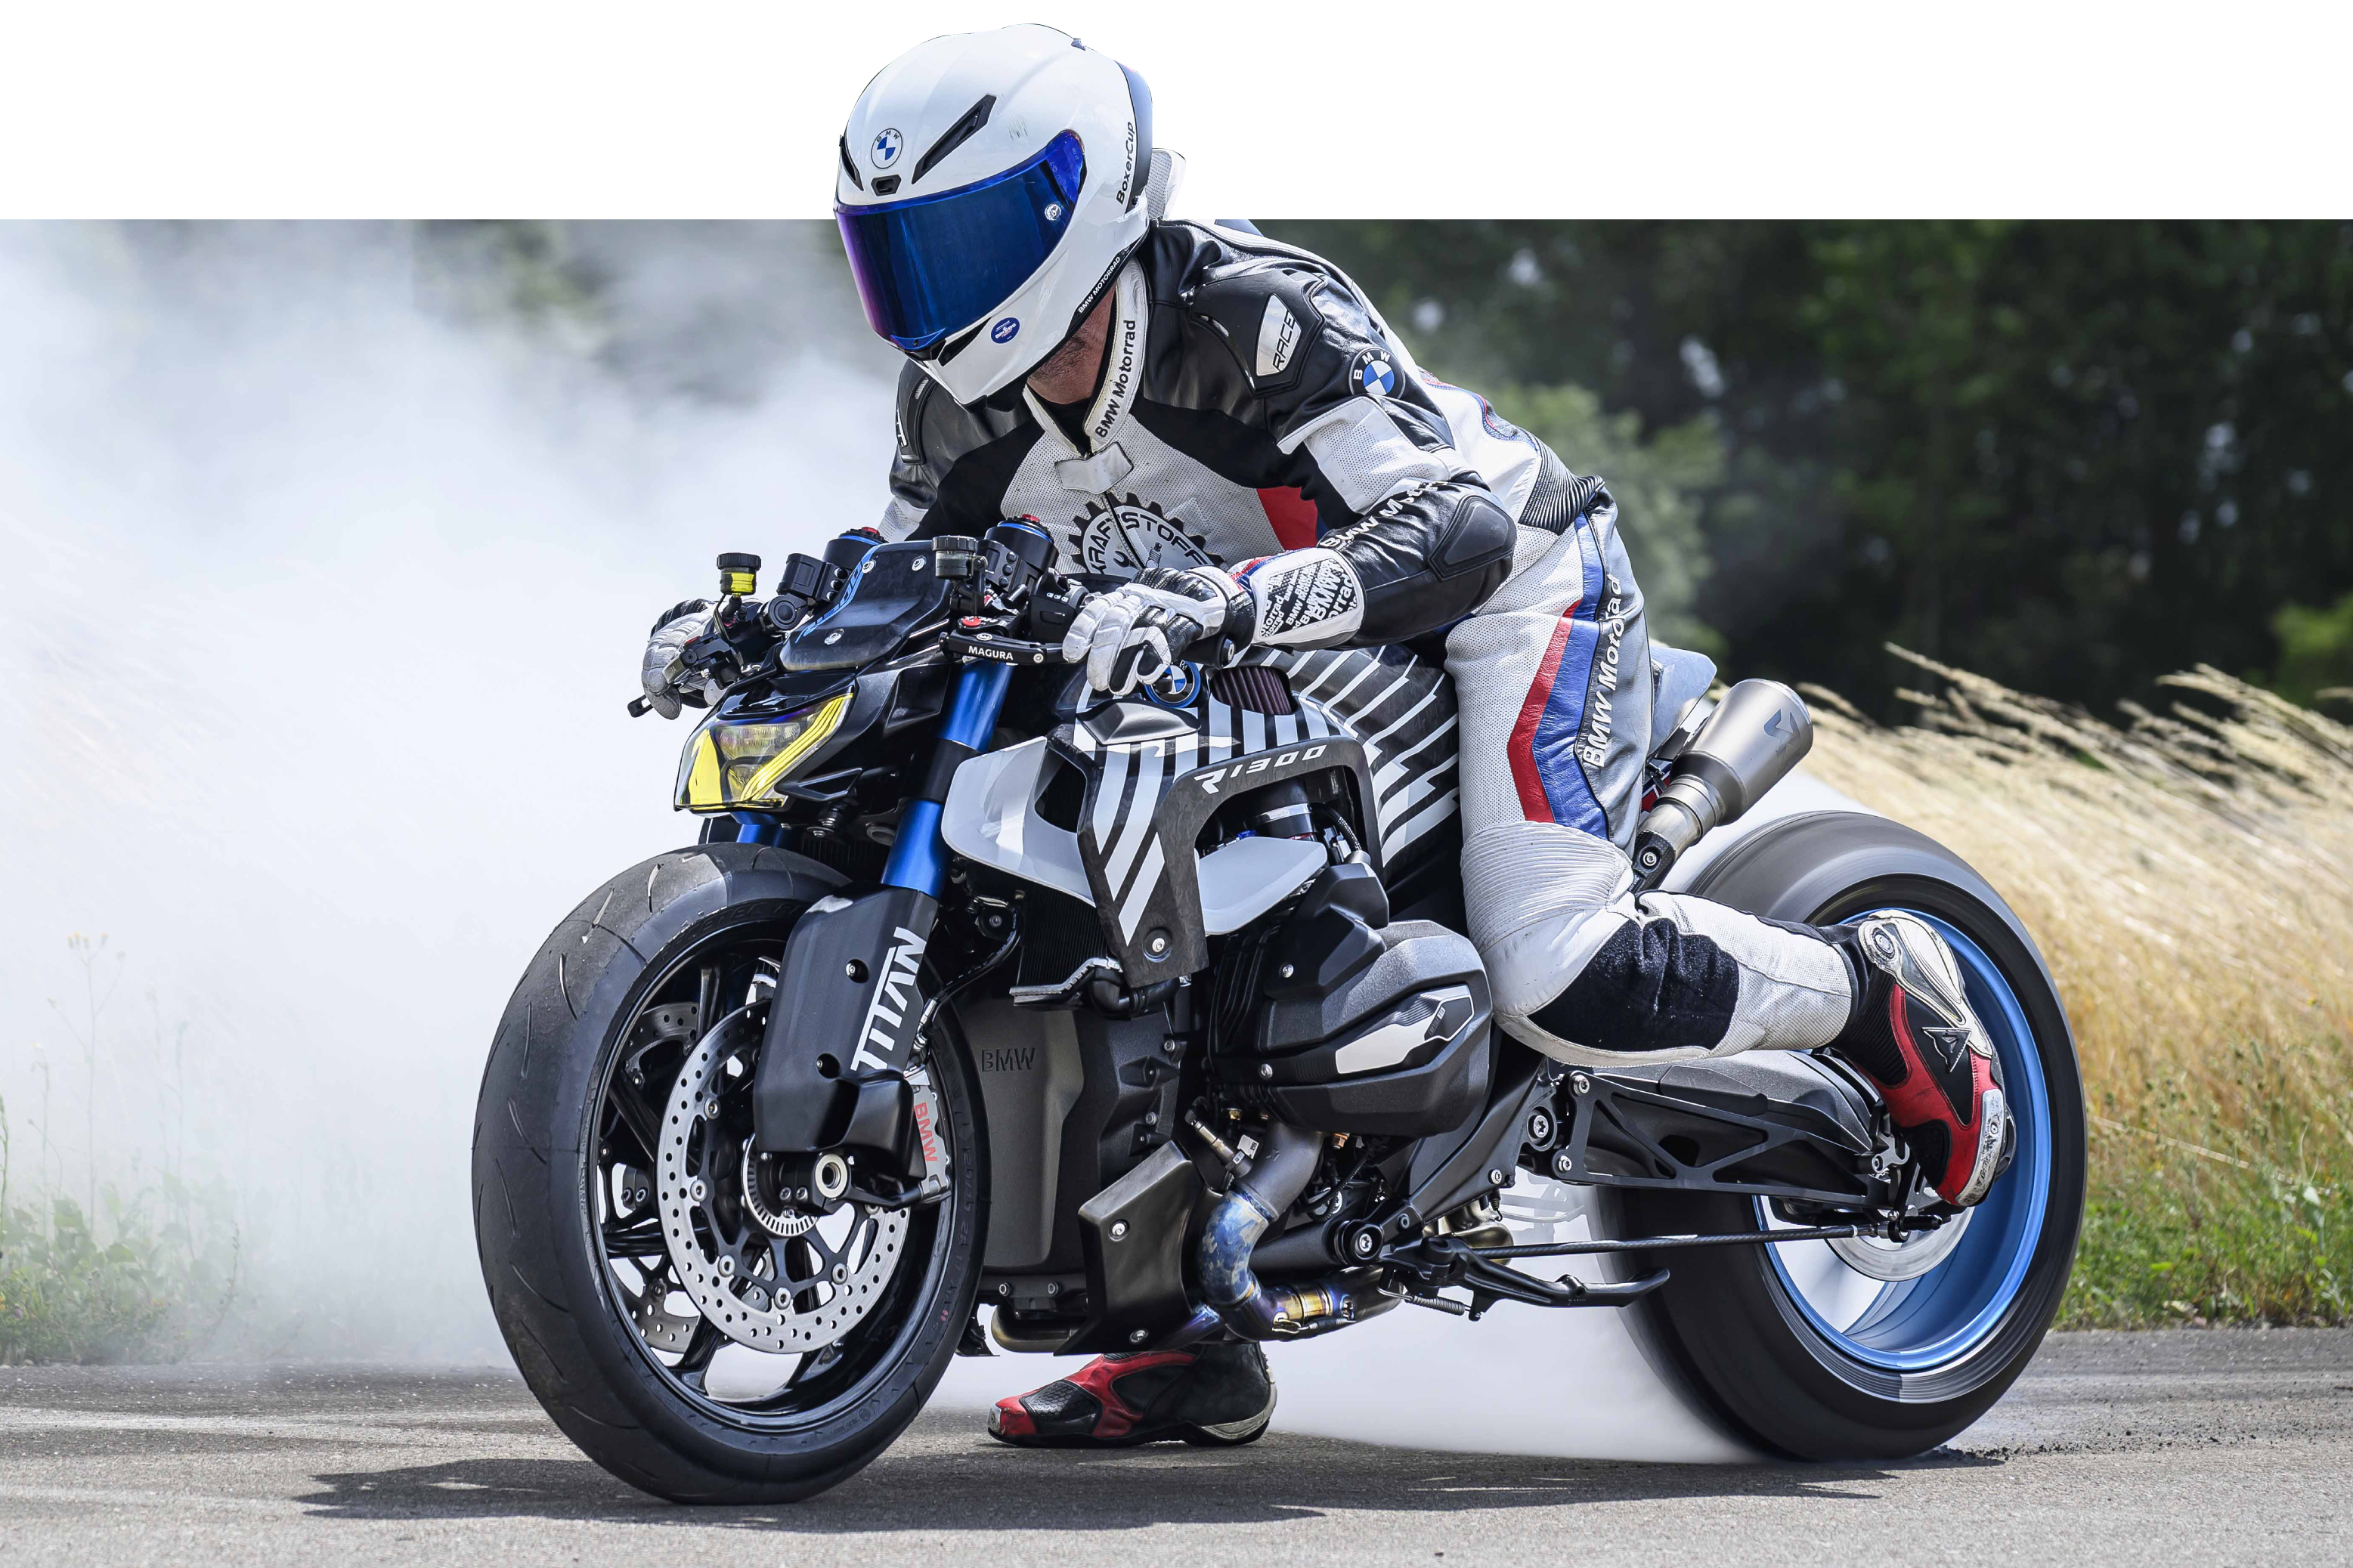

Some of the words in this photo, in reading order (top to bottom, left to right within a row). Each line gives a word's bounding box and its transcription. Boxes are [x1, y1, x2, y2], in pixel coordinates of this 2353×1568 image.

[876, 130, 900, 143] BMW
[1116, 121, 1135, 205] BoxerCup
[1078, 293, 1094, 314] BMW
[1092, 256, 1121, 295] MOTORRAD
[1272, 308, 1296, 372] RACE
[1353, 351, 1391, 380] BMW
[1094, 398, 1121, 438] BMW
[1112, 320, 1136, 399] Motorrad
[1286, 599, 1304, 626] BMW
[968, 645, 1014, 661] MAGURA
[1582, 690, 1613, 768] BMW
[1599, 573, 1625, 691] Motorad
[850, 926, 927, 1072] TITAN
[982, 1047, 1036, 1072] BMW
[913, 1101, 938, 1161] BMW
